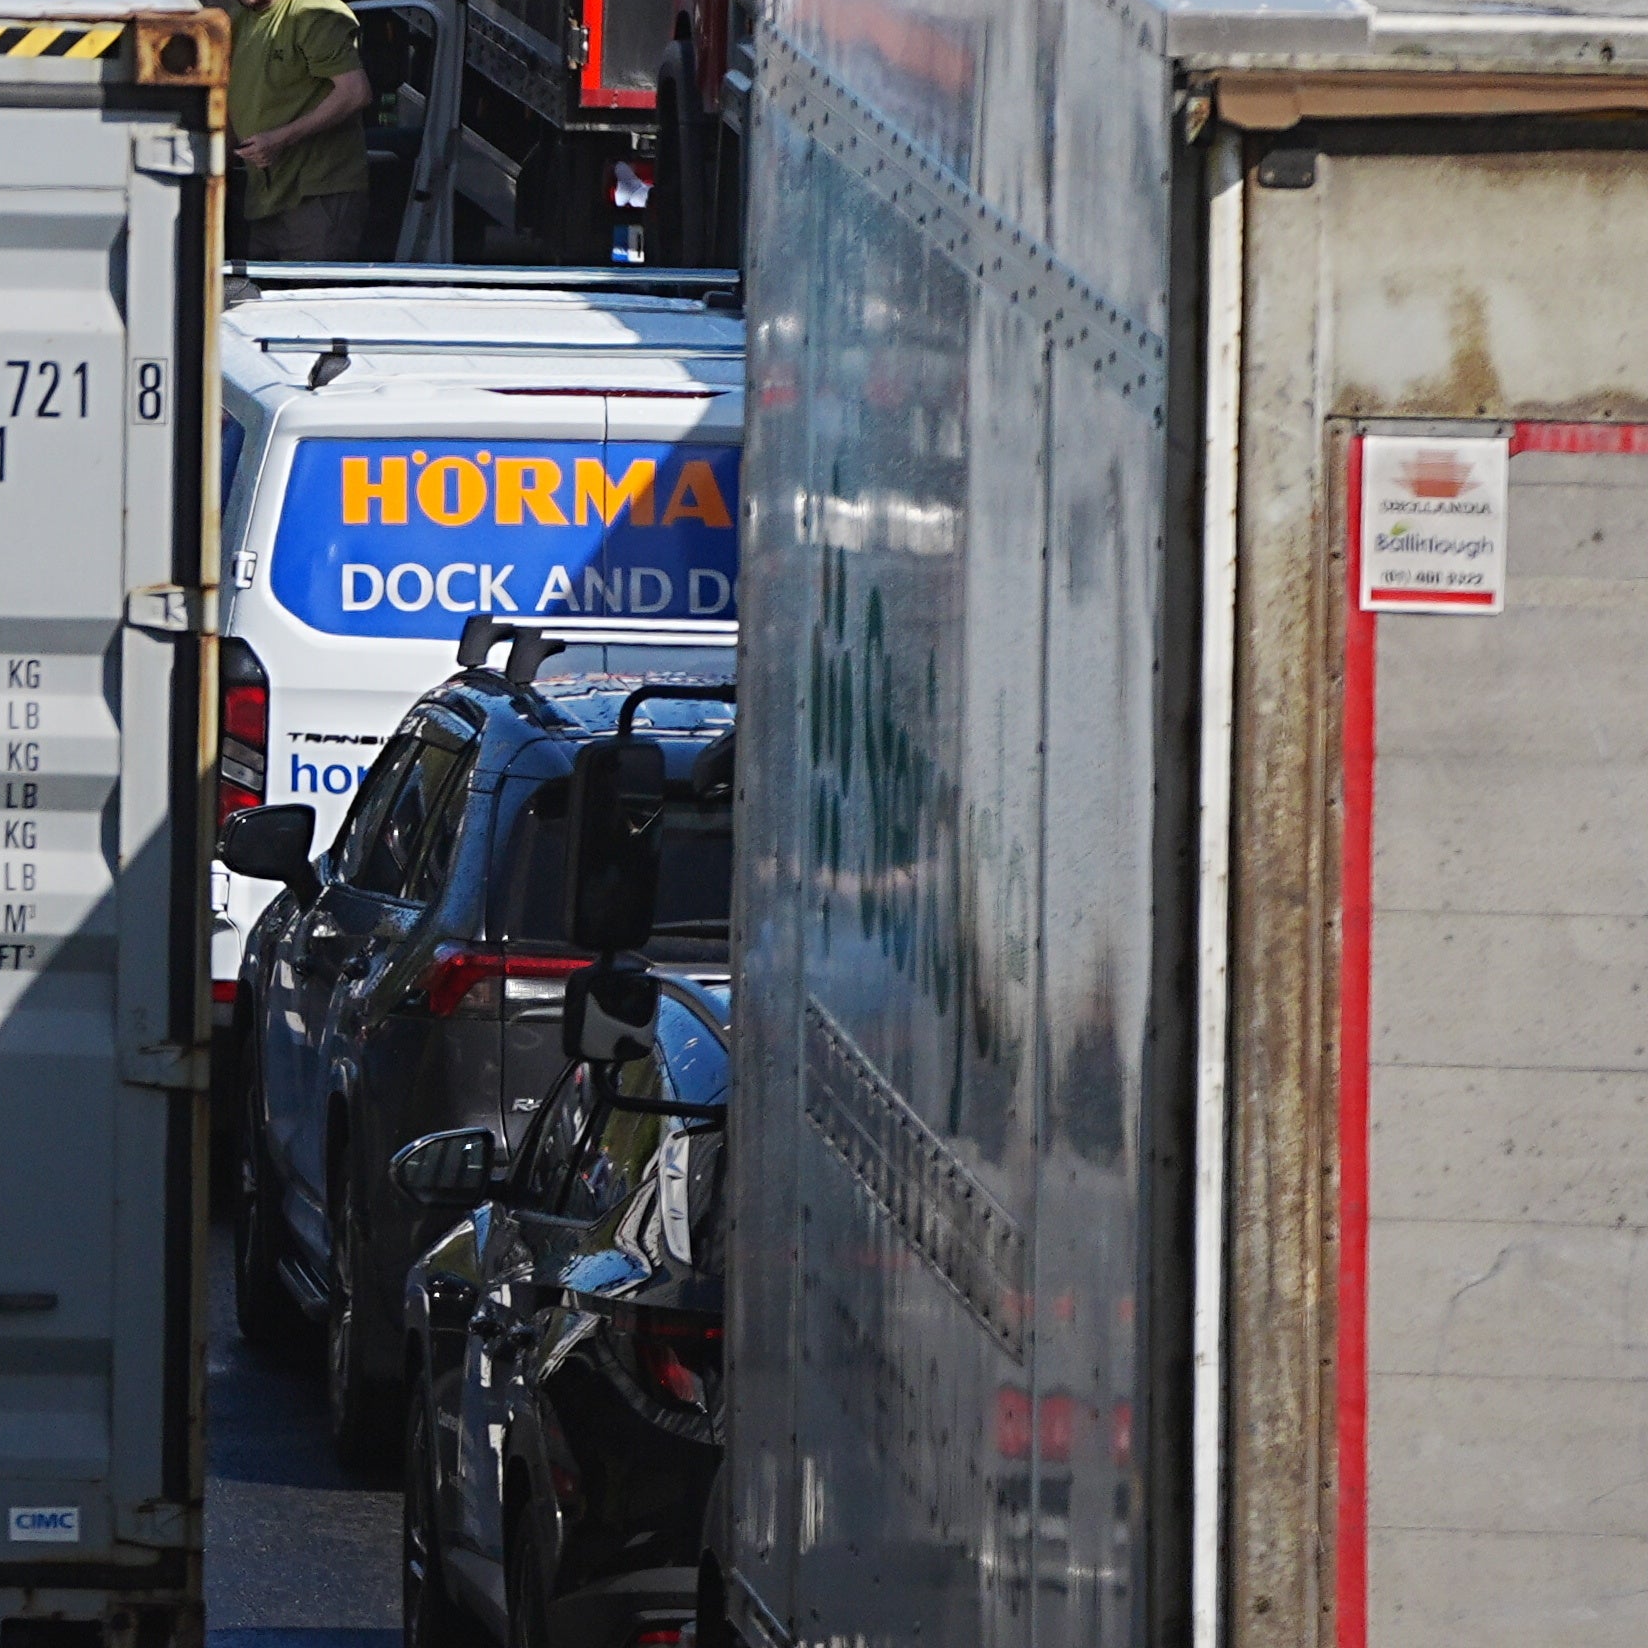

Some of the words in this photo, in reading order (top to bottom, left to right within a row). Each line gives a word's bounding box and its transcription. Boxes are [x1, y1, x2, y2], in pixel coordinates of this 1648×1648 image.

[5, 360, 89, 418] 721
[138, 362, 163, 420] 8
[342, 562, 519, 613] DOCK
[534, 565, 674, 614] AND
[688, 567, 739, 614] D
[7, 659, 42, 689] KG
[8, 701, 40, 731] LB
[287, 733, 393, 745] TRANSI
[7, 742, 40, 772] KG
[5, 783, 38, 809] LB
[4, 820, 38, 850] KG
[5, 863, 37, 892] LB
[15, 1512, 74, 1531] CIMC
